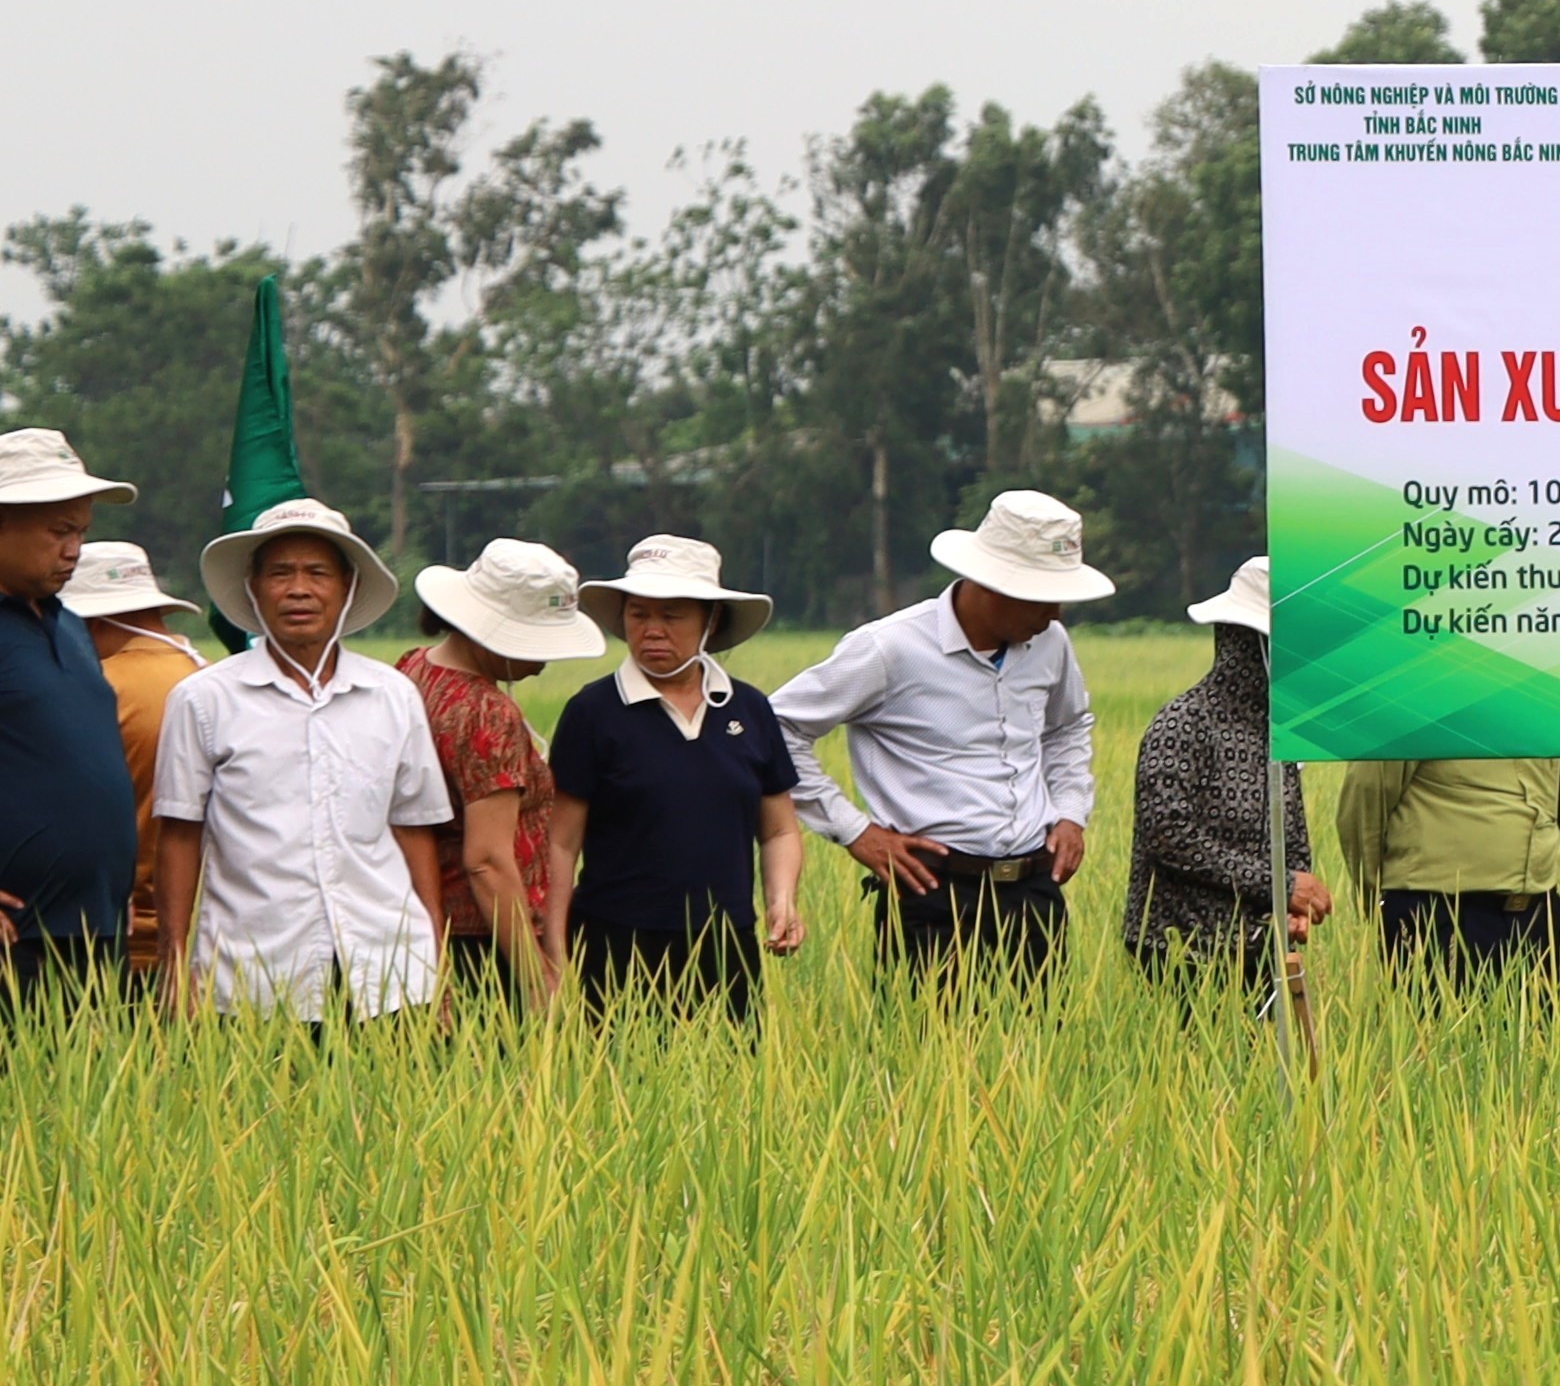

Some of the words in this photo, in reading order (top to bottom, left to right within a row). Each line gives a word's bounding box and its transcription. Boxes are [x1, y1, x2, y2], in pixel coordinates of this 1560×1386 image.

[1294, 80, 1317, 105] SỞ
[1320, 82, 1366, 106] NÔNG
[1370, 82, 1430, 109] NGHIỆP
[1433, 82, 1456, 106] VÀ
[1459, 82, 1491, 106] MÔI
[1494, 82, 1559, 106] TRƯỜNG
[1363, 109, 1401, 135] TỈNH
[1404, 109, 1438, 135] BẮC
[1441, 115, 1482, 135] NINH
[1287, 142, 1341, 162] TRUNG
[1344, 139, 1380, 163] TÂM
[1384, 137, 1448, 163] KHUYẾN
[1452, 139, 1498, 162] NÔNG
[1501, 137, 1534, 162] BẮC
[1361, 325, 1481, 424] SẢN
[1403, 479, 1460, 512] Quy
[1467, 478, 1518, 506] mô:
[1402, 521, 1476, 554] Ngày
[1483, 515, 1539, 553] cấy:
[1403, 564, 1443, 595] Dự
[1448, 558, 1508, 590] kiến
[1402, 608, 1443, 639] Dự
[1448, 602, 1508, 635] kiến
